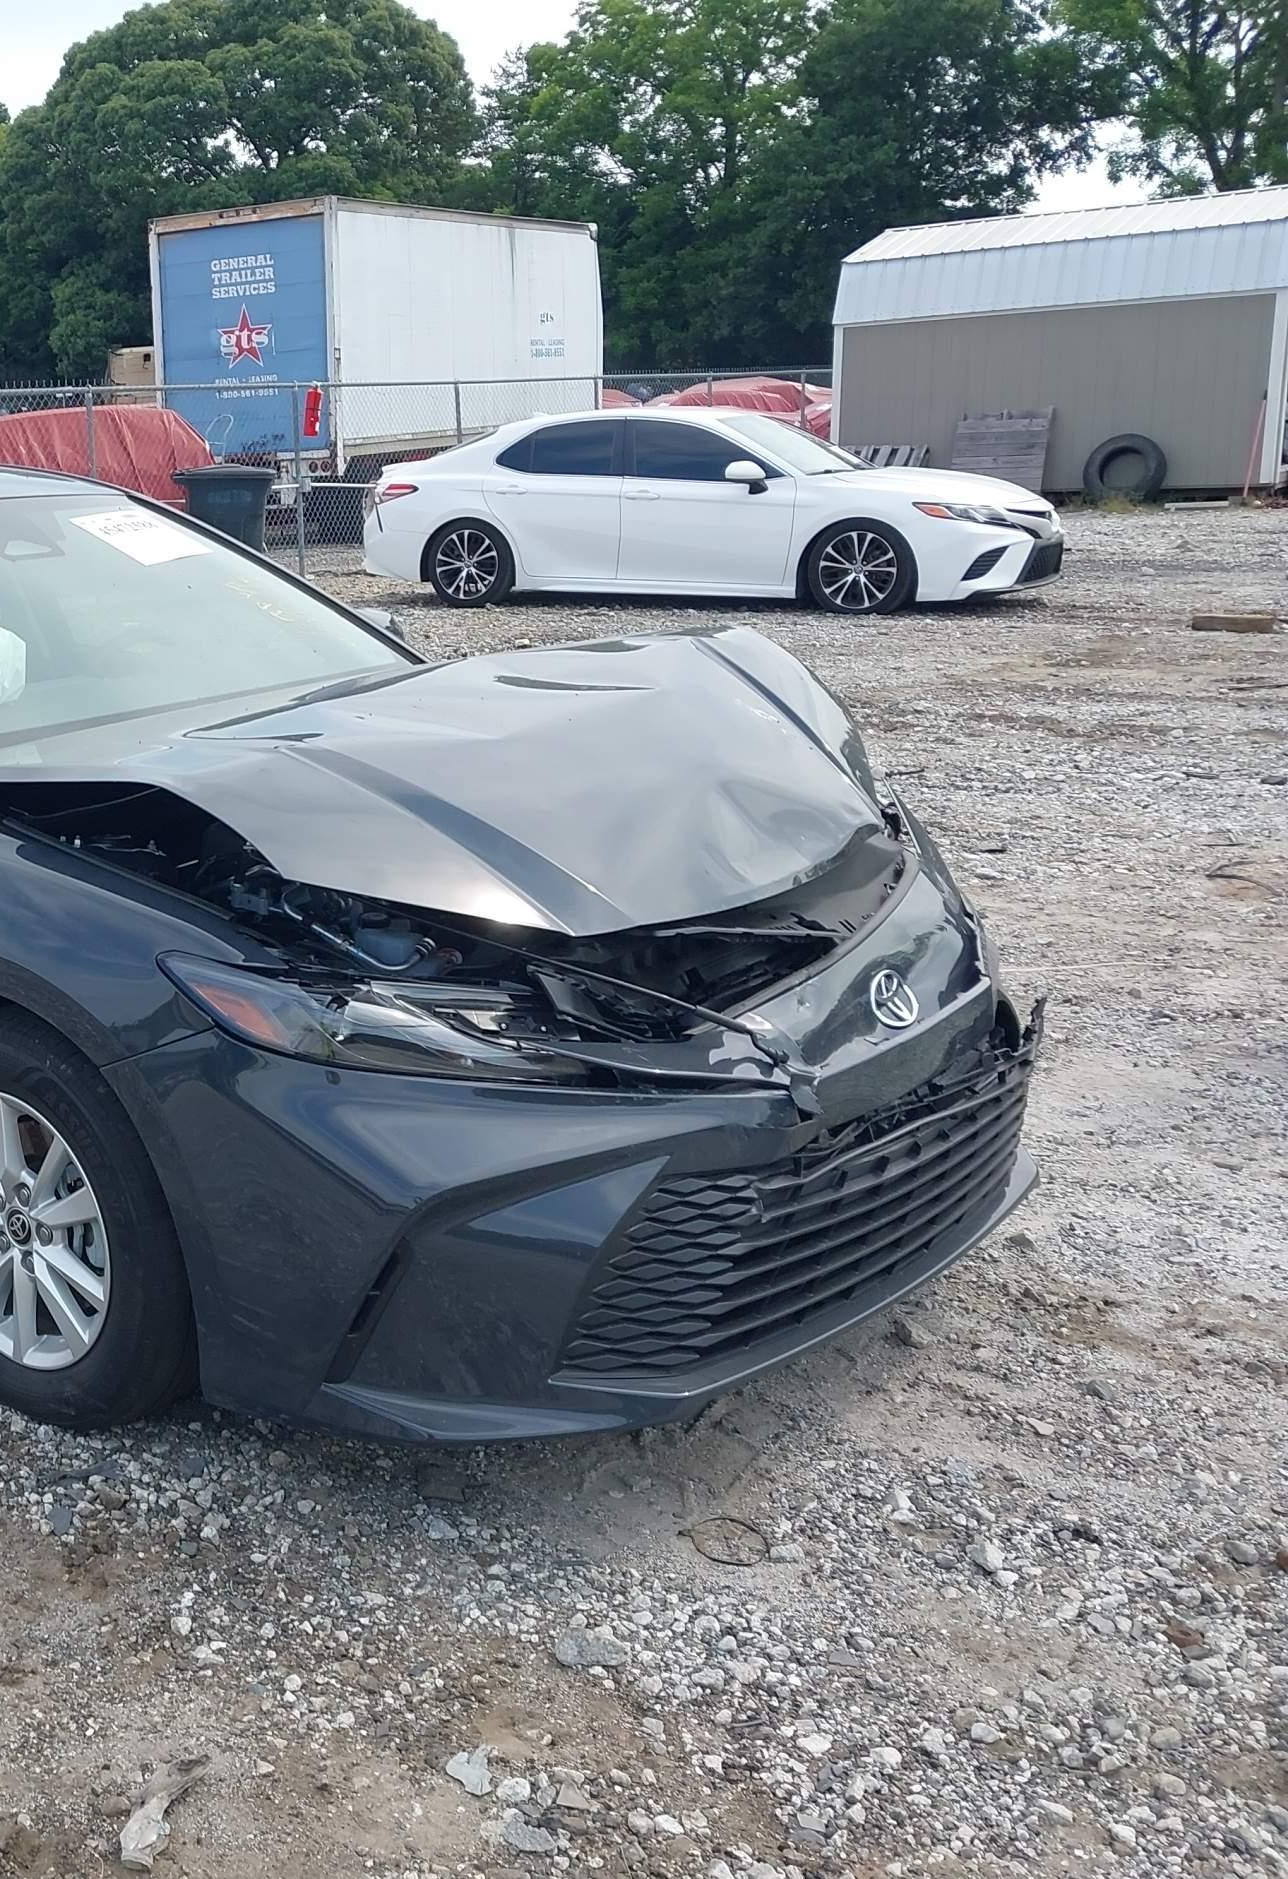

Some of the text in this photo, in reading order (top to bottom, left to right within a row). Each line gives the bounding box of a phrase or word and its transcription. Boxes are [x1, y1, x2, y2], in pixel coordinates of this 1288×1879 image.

[211, 254, 274, 271] GENERAL
[212, 267, 274, 285] TRAILER
[212, 282, 275, 299] SERVICES
[220, 328, 269, 359] gts
